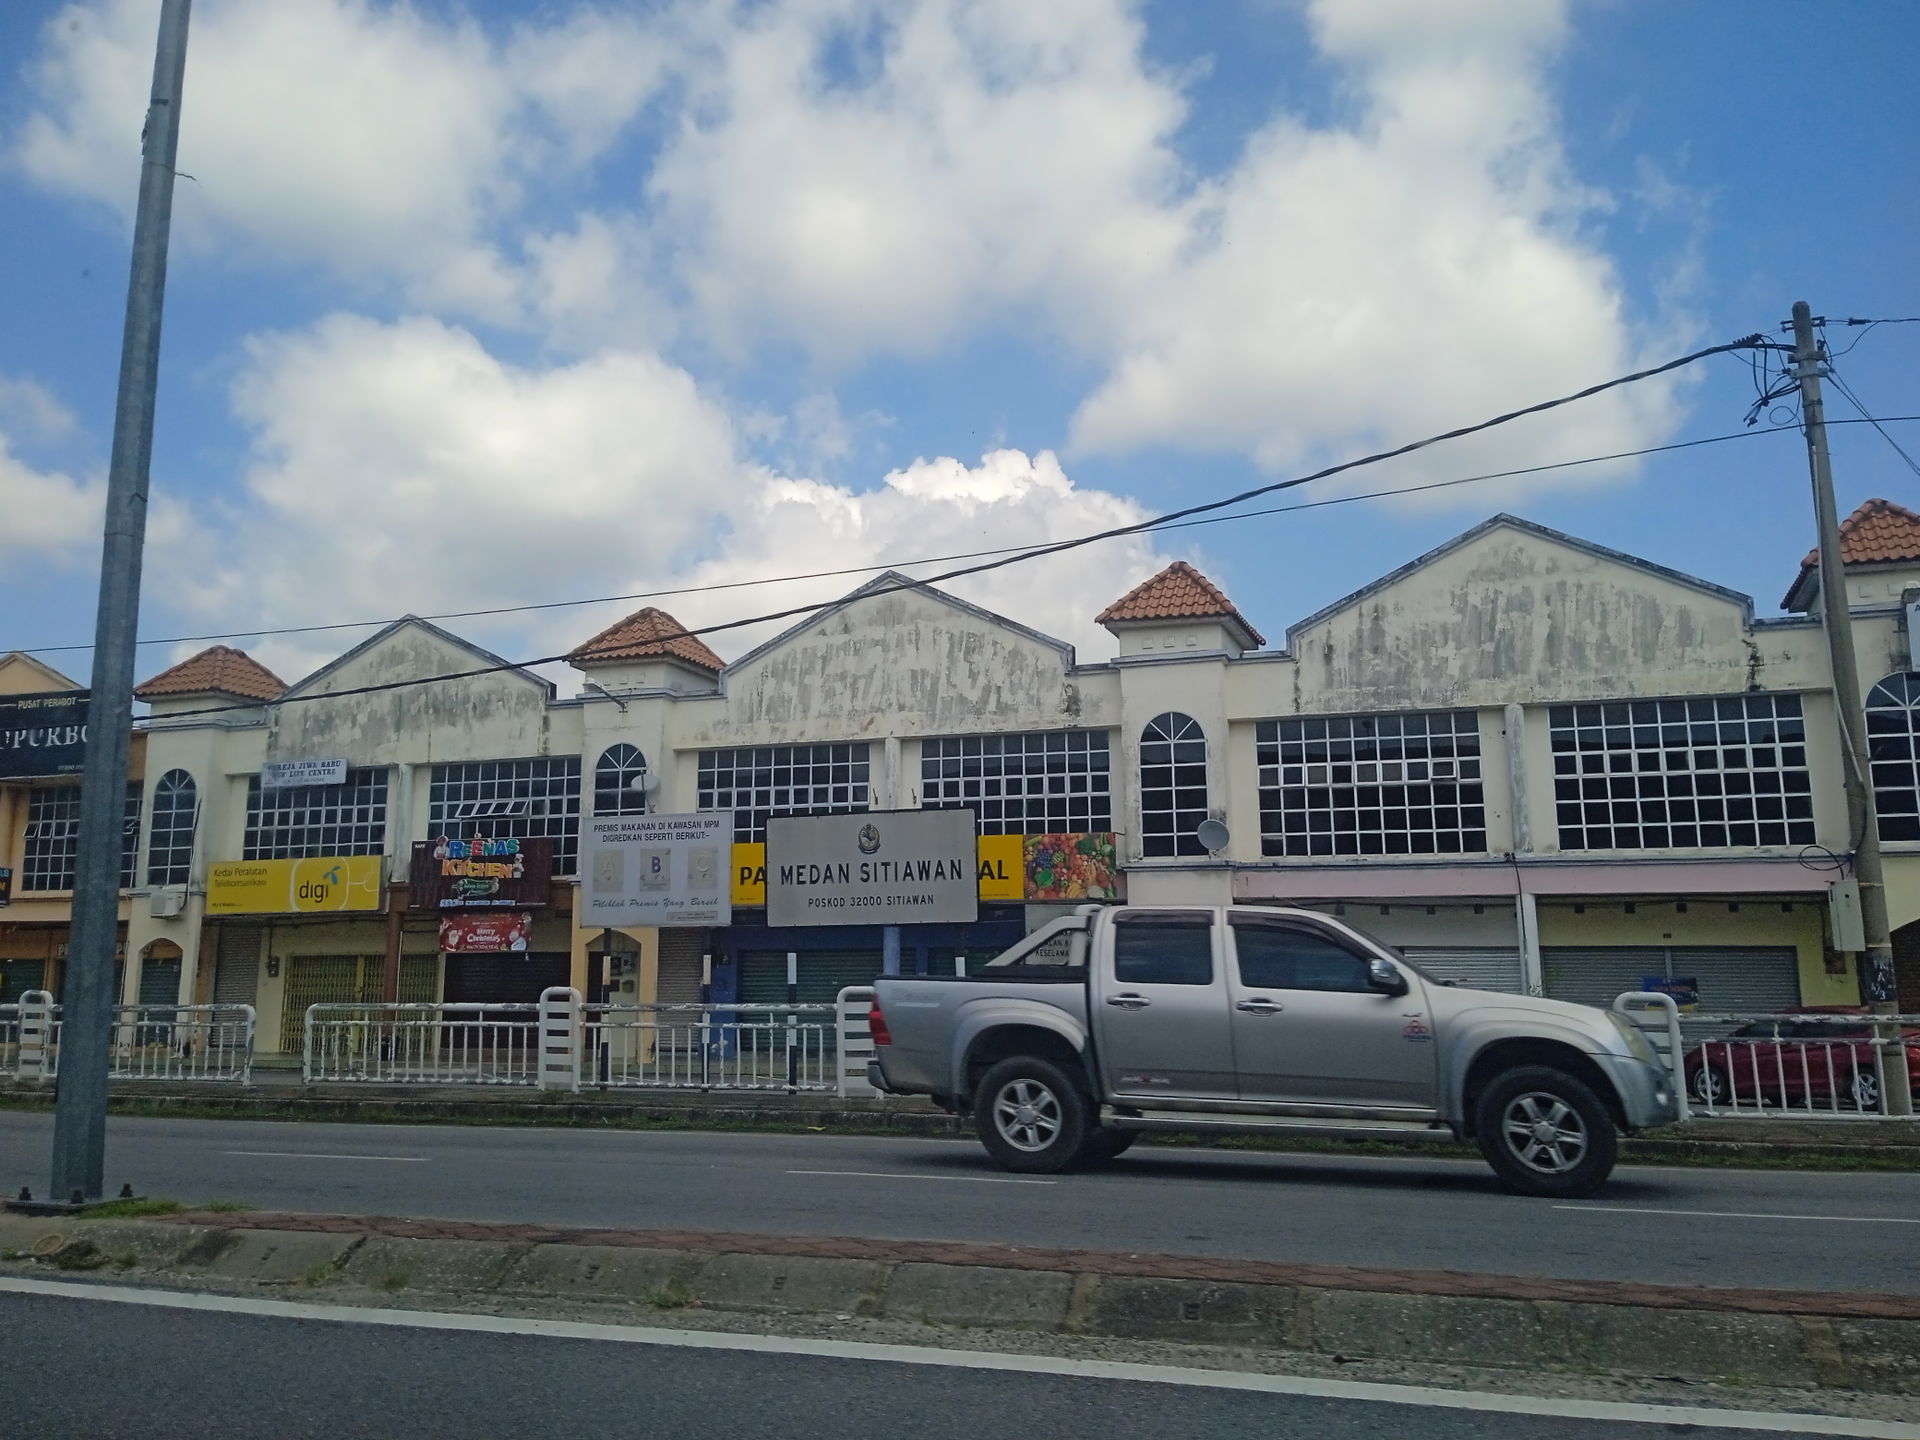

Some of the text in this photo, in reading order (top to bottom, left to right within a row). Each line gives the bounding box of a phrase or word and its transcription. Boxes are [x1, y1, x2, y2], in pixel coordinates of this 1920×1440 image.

[18, 697, 78, 709] PUSAT PERABOT
[593, 820, 720, 833] PREMIS MAKANAN DI KAWASAN MPM
[602, 832, 643, 843] DIGREDKAN
[644, 831, 674, 841] SEPERTI
[651, 856, 661, 873] B
[214, 867, 267, 877] Kedai Peralatan
[740, 859, 1009, 886] PA AL
[780, 859, 962, 885] MEDAN SITIAWAN
[299, 881, 328, 903] digi
[629, 898, 660, 907] Premis
[663, 897, 684, 909] Yang
[808, 895, 934, 908] POSKOD 32000 SITIAWAN
[1035, 949, 1070, 957] KESELAMA
